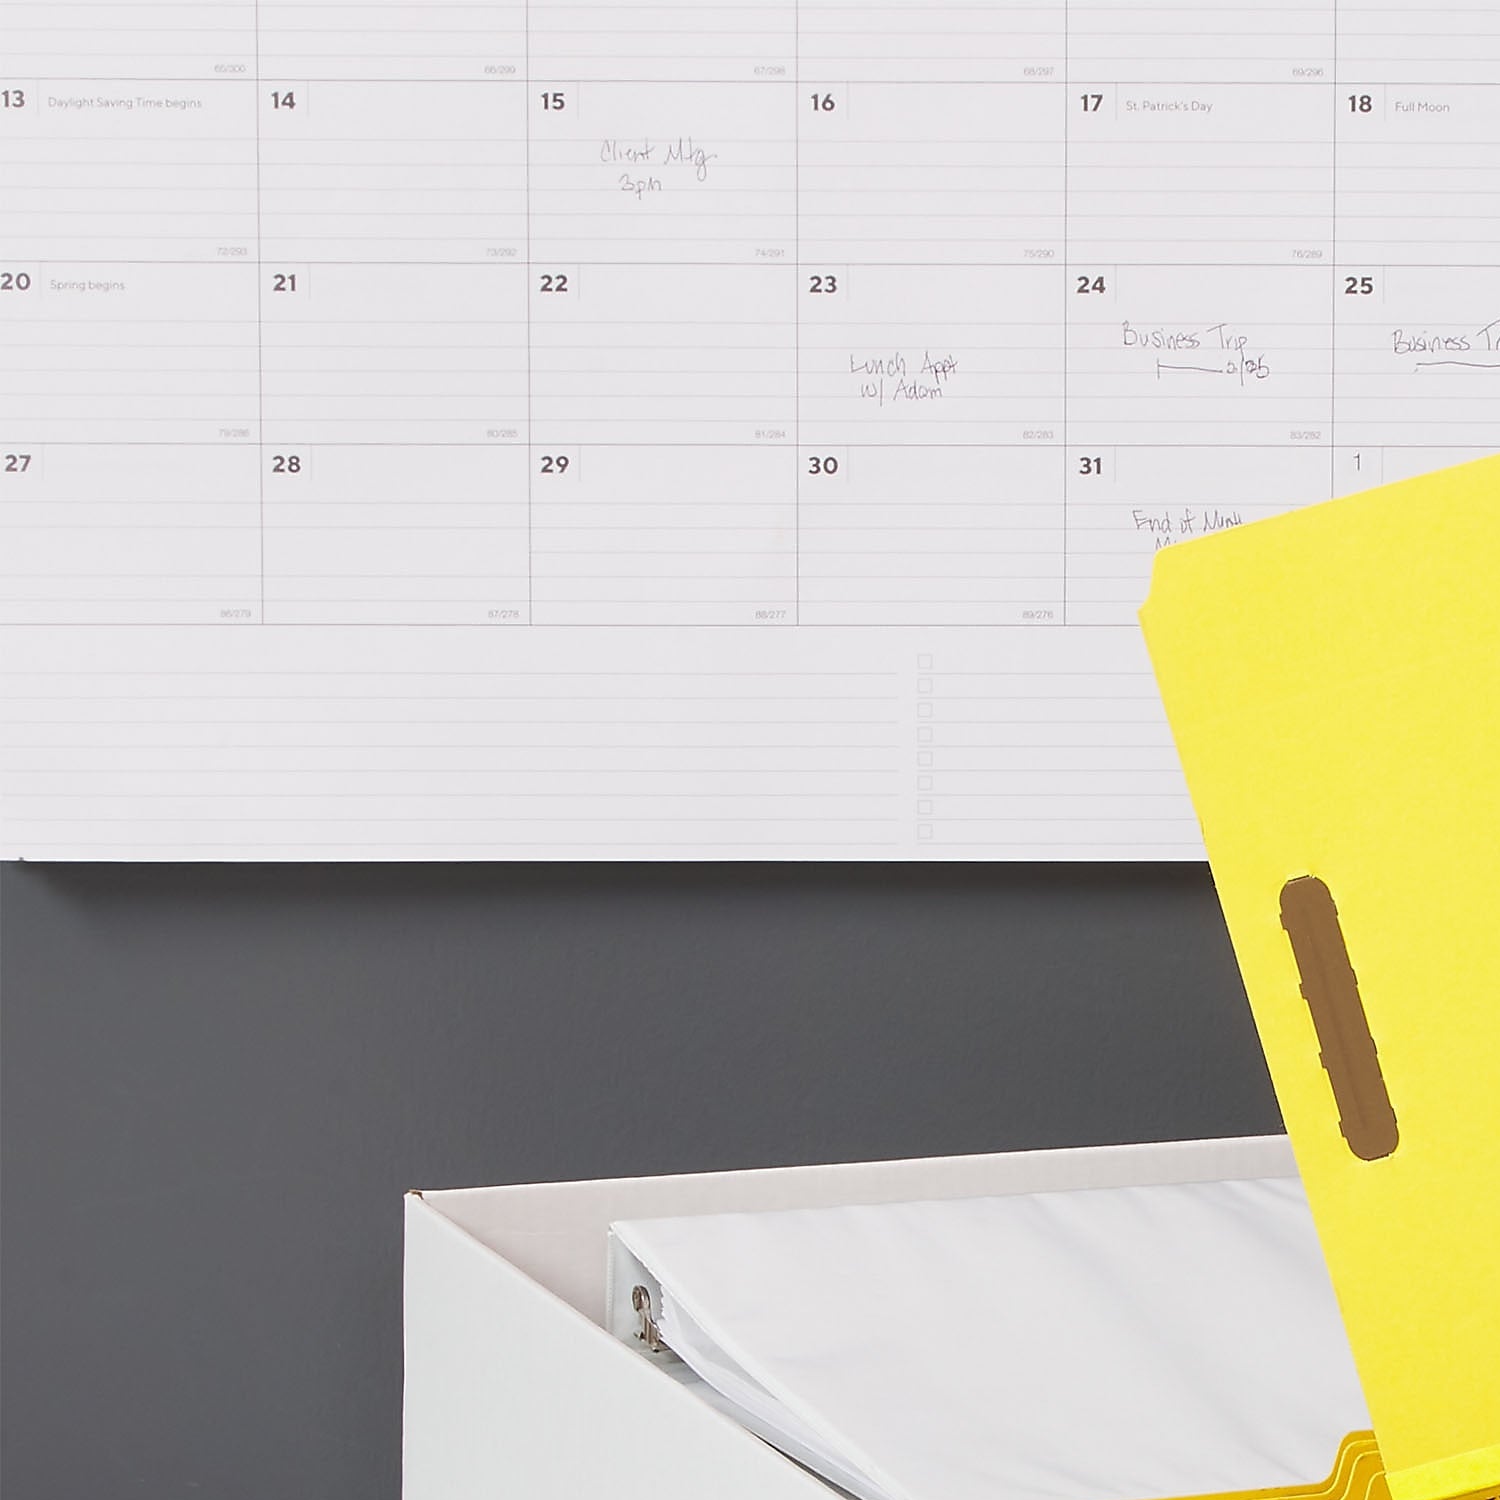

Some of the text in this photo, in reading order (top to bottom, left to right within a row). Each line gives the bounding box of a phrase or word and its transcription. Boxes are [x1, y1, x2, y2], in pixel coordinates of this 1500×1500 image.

[1, 89, 25, 108] 13
[48, 96, 203, 111] Daylight Saving Time begins
[271, 91, 297, 110] 14
[541, 92, 565, 111] 15
[810, 93, 836, 112] 16
[1080, 94, 1104, 112] 17
[1125, 100, 1214, 114] St. Patrick's Day
[1348, 94, 1373, 113] 18
[1394, 101, 1451, 113] Full Moon
[0, 272, 31, 291] 20
[50, 278, 126, 293] Spring begins
[273, 273, 296, 292] 21
[539, 274, 568, 293] 22
[809, 275, 838, 294] 23
[1076, 275, 1106, 294] 24
[1344, 276, 1374, 295] 25
[1122, 320, 1247, 357] Business Trip
[1393, 328, 1471, 355] Business
[850, 350, 958, 385] Lunch Appt
[893, 378, 943, 401] Adam
[4, 454, 32, 473] 27
[272, 455, 301, 474] 28
[540, 455, 570, 474] 29
[808, 456, 839, 475] 30
[1079, 456, 1102, 475] 31
[1352, 453, 1362, 471] 1
[1132, 509, 1172, 533] End
[1180, 507, 1196, 533] of
